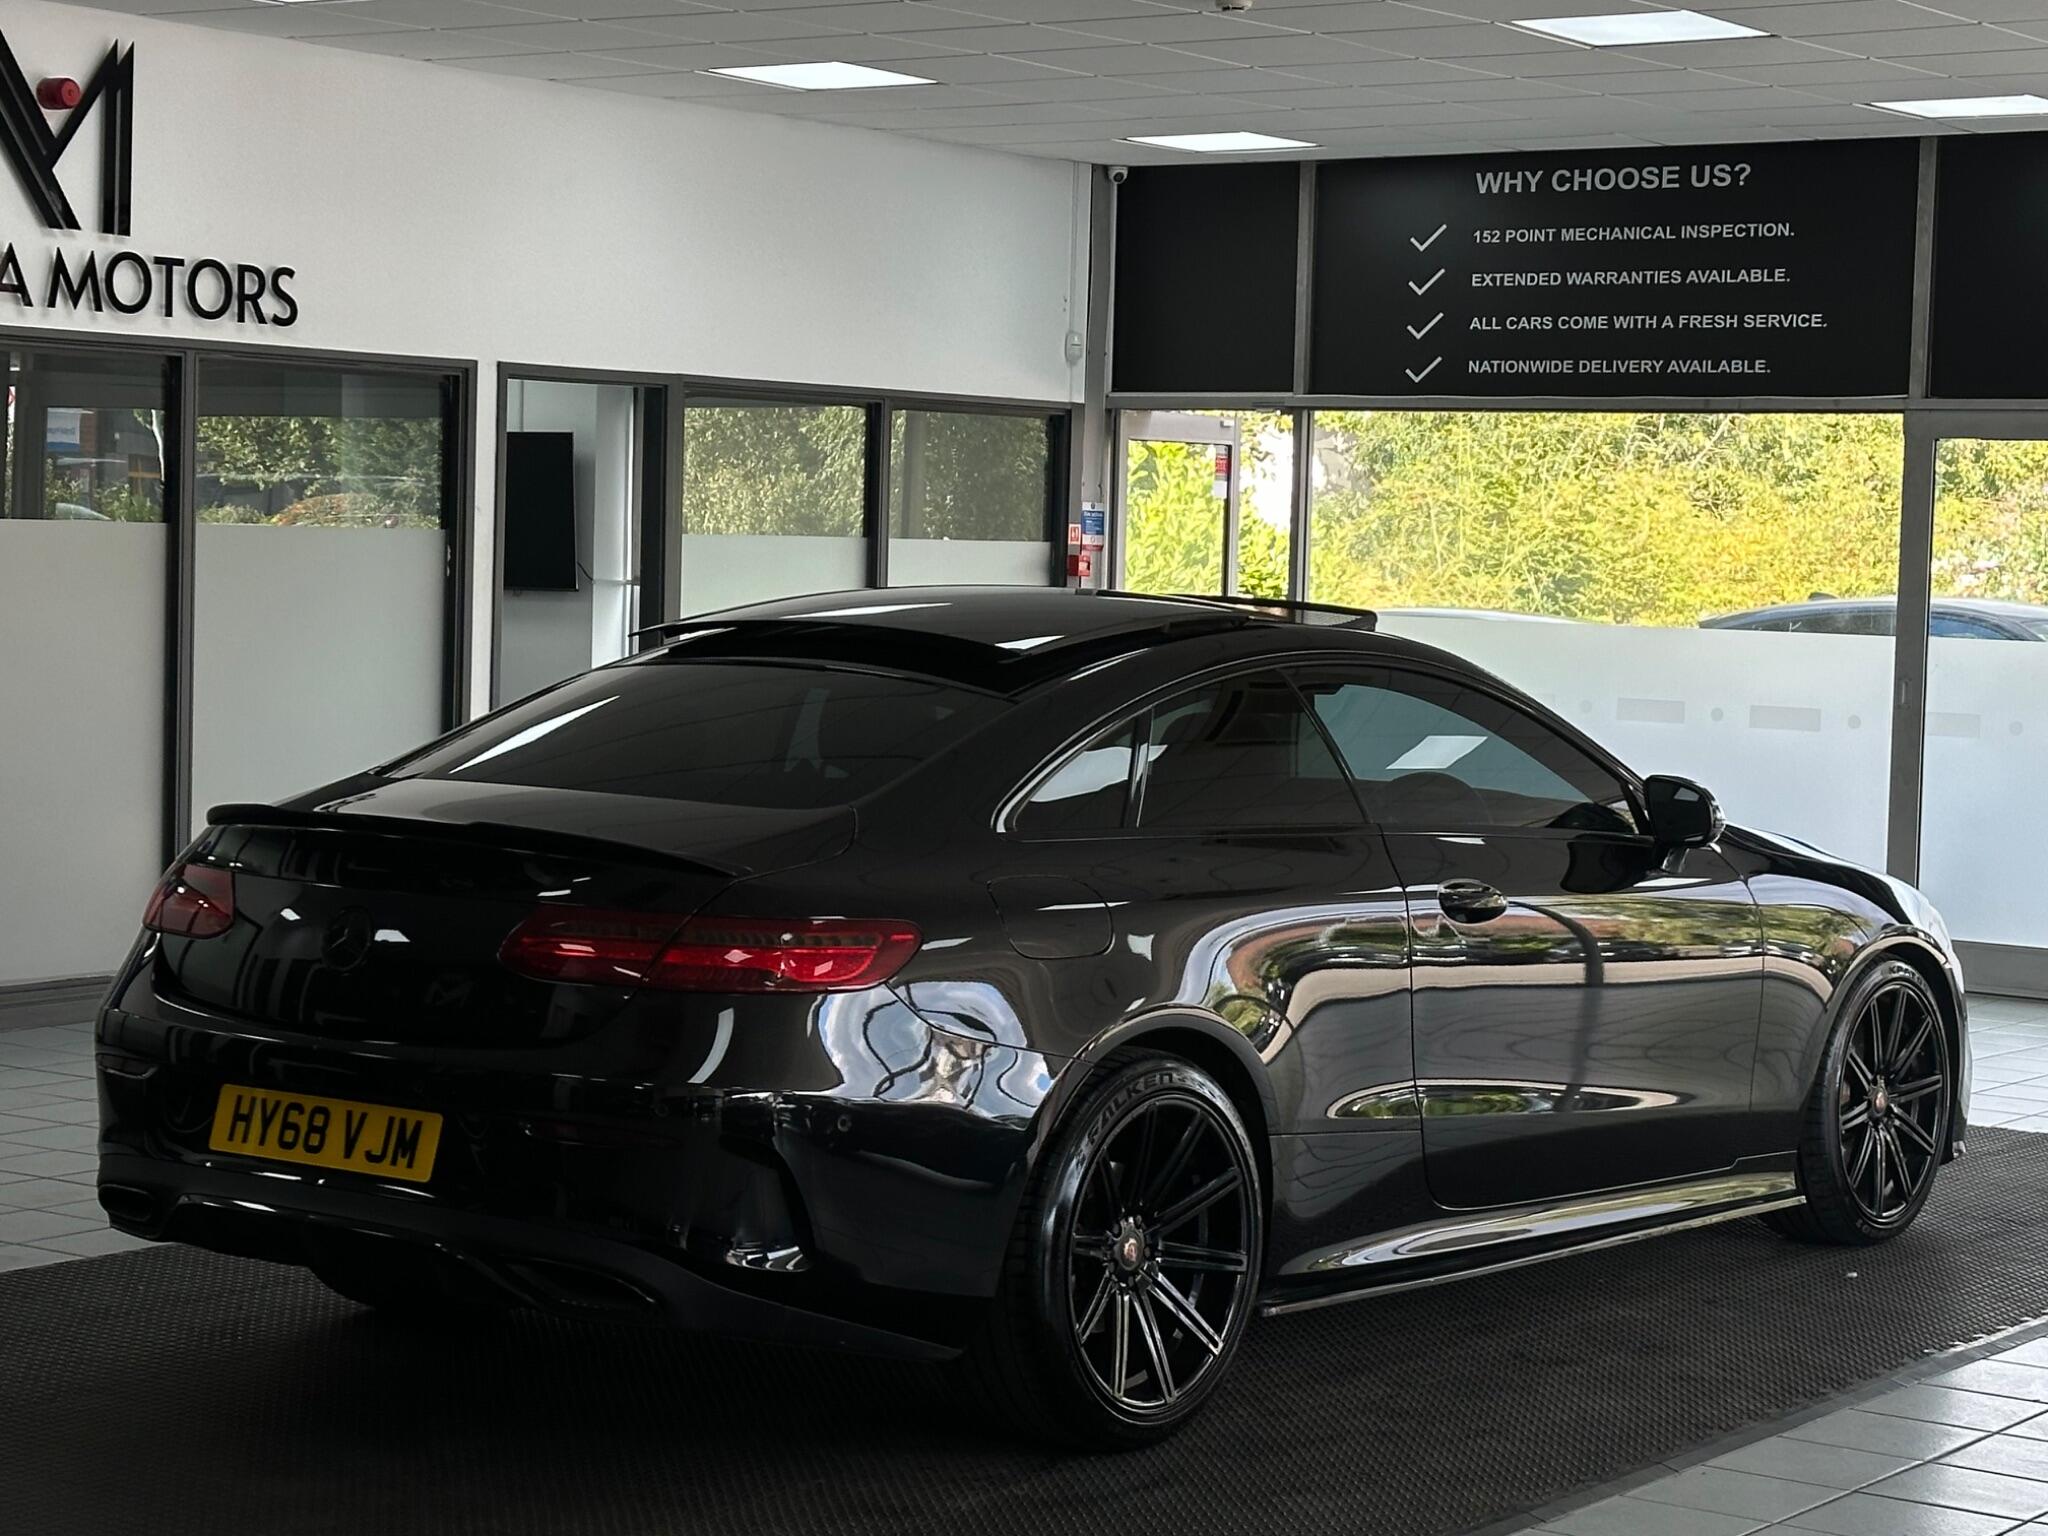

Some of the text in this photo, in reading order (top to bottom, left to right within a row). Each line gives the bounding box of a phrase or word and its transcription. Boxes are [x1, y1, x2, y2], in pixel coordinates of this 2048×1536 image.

[1476, 163, 1751, 194] WHY CHOOSE US?
[1473, 223, 1795, 243] 152 POINT MECHANICAL INSPECTION.
[47, 248, 298, 327] MOTORS
[1471, 268, 1791, 287] EXTENDED WARRANTIES AVAILABLE.
[1469, 313, 1828, 330] ALL CARS COME WITH A FRESH SERVICE.
[1468, 359, 1771, 374] NATIONWIDE DELIVERY AVAILABLE.
[1087, 1072, 1174, 1145] FALKEN
[227, 1094, 423, 1169] HY68 VJM
